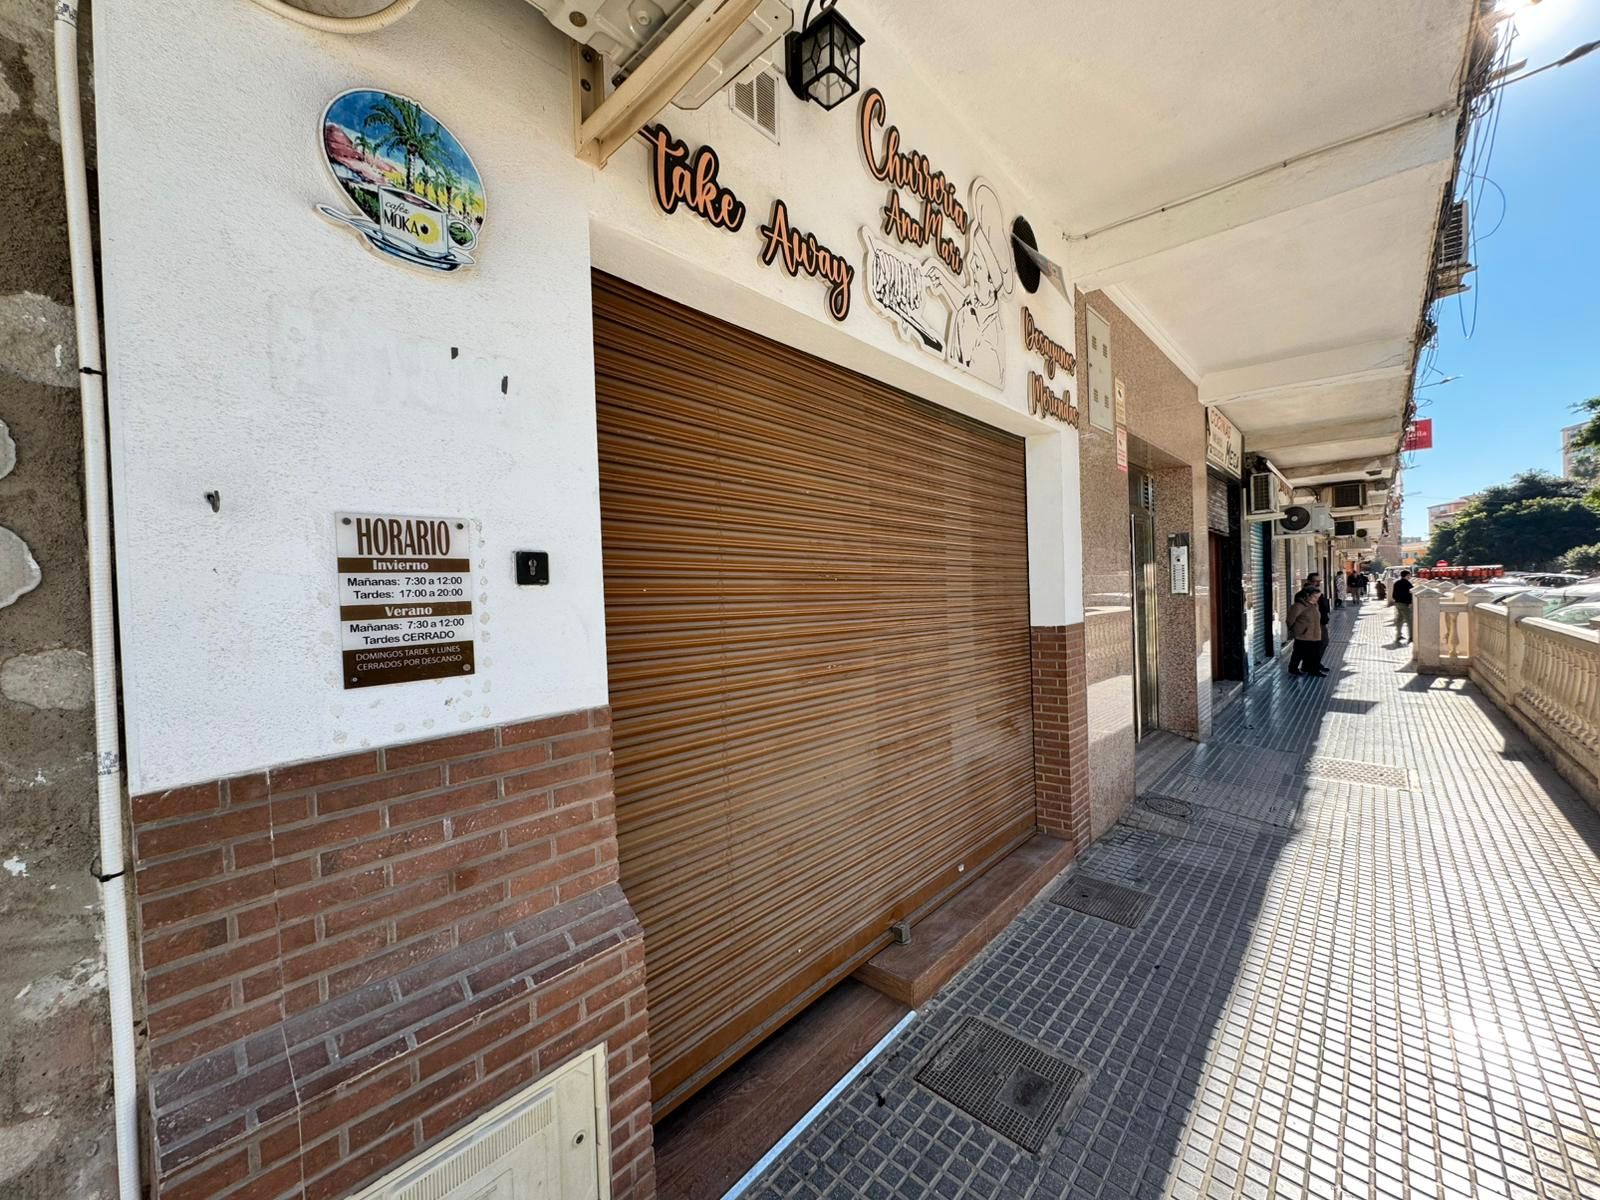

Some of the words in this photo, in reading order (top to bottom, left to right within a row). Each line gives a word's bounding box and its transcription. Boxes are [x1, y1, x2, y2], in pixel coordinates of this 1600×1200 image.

[861, 88, 967, 234] Churreria
[384, 209, 419, 237] MOKA
[884, 189, 923, 248] Ana
[923, 200, 963, 275] Mari
[761, 199, 854, 321] Away
[1024, 306, 1076, 380] Desayunos
[356, 517, 450, 556] HORARIO
[372, 559, 429, 571] Invierno
[347, 577, 400, 587] Mañanas:
[404, 576, 426, 586] 7:30
[437, 576, 463, 586] 12:00
[353, 590, 394, 600] Tardes:
[399, 589, 427, 598] 17:00
[437, 588, 463, 597] 20:00
[385, 606, 433, 617] Verano
[349, 623, 402, 634] Mañanas:
[407, 620, 429, 630] 7:30
[439, 618, 465, 628] 12:00
[362, 635, 400, 646] Tardes
[401, 630, 455, 642] CERRADO
[355, 650, 403, 662] DOMINGOS
[404, 647, 430, 657] TARDE
[430, 647, 435, 655] Y
[437, 645, 461, 653] LUNES
[356, 660, 402, 672] CERRADOS
[403, 657, 420, 666] POR
[421, 654, 462, 665] DESCANSO
